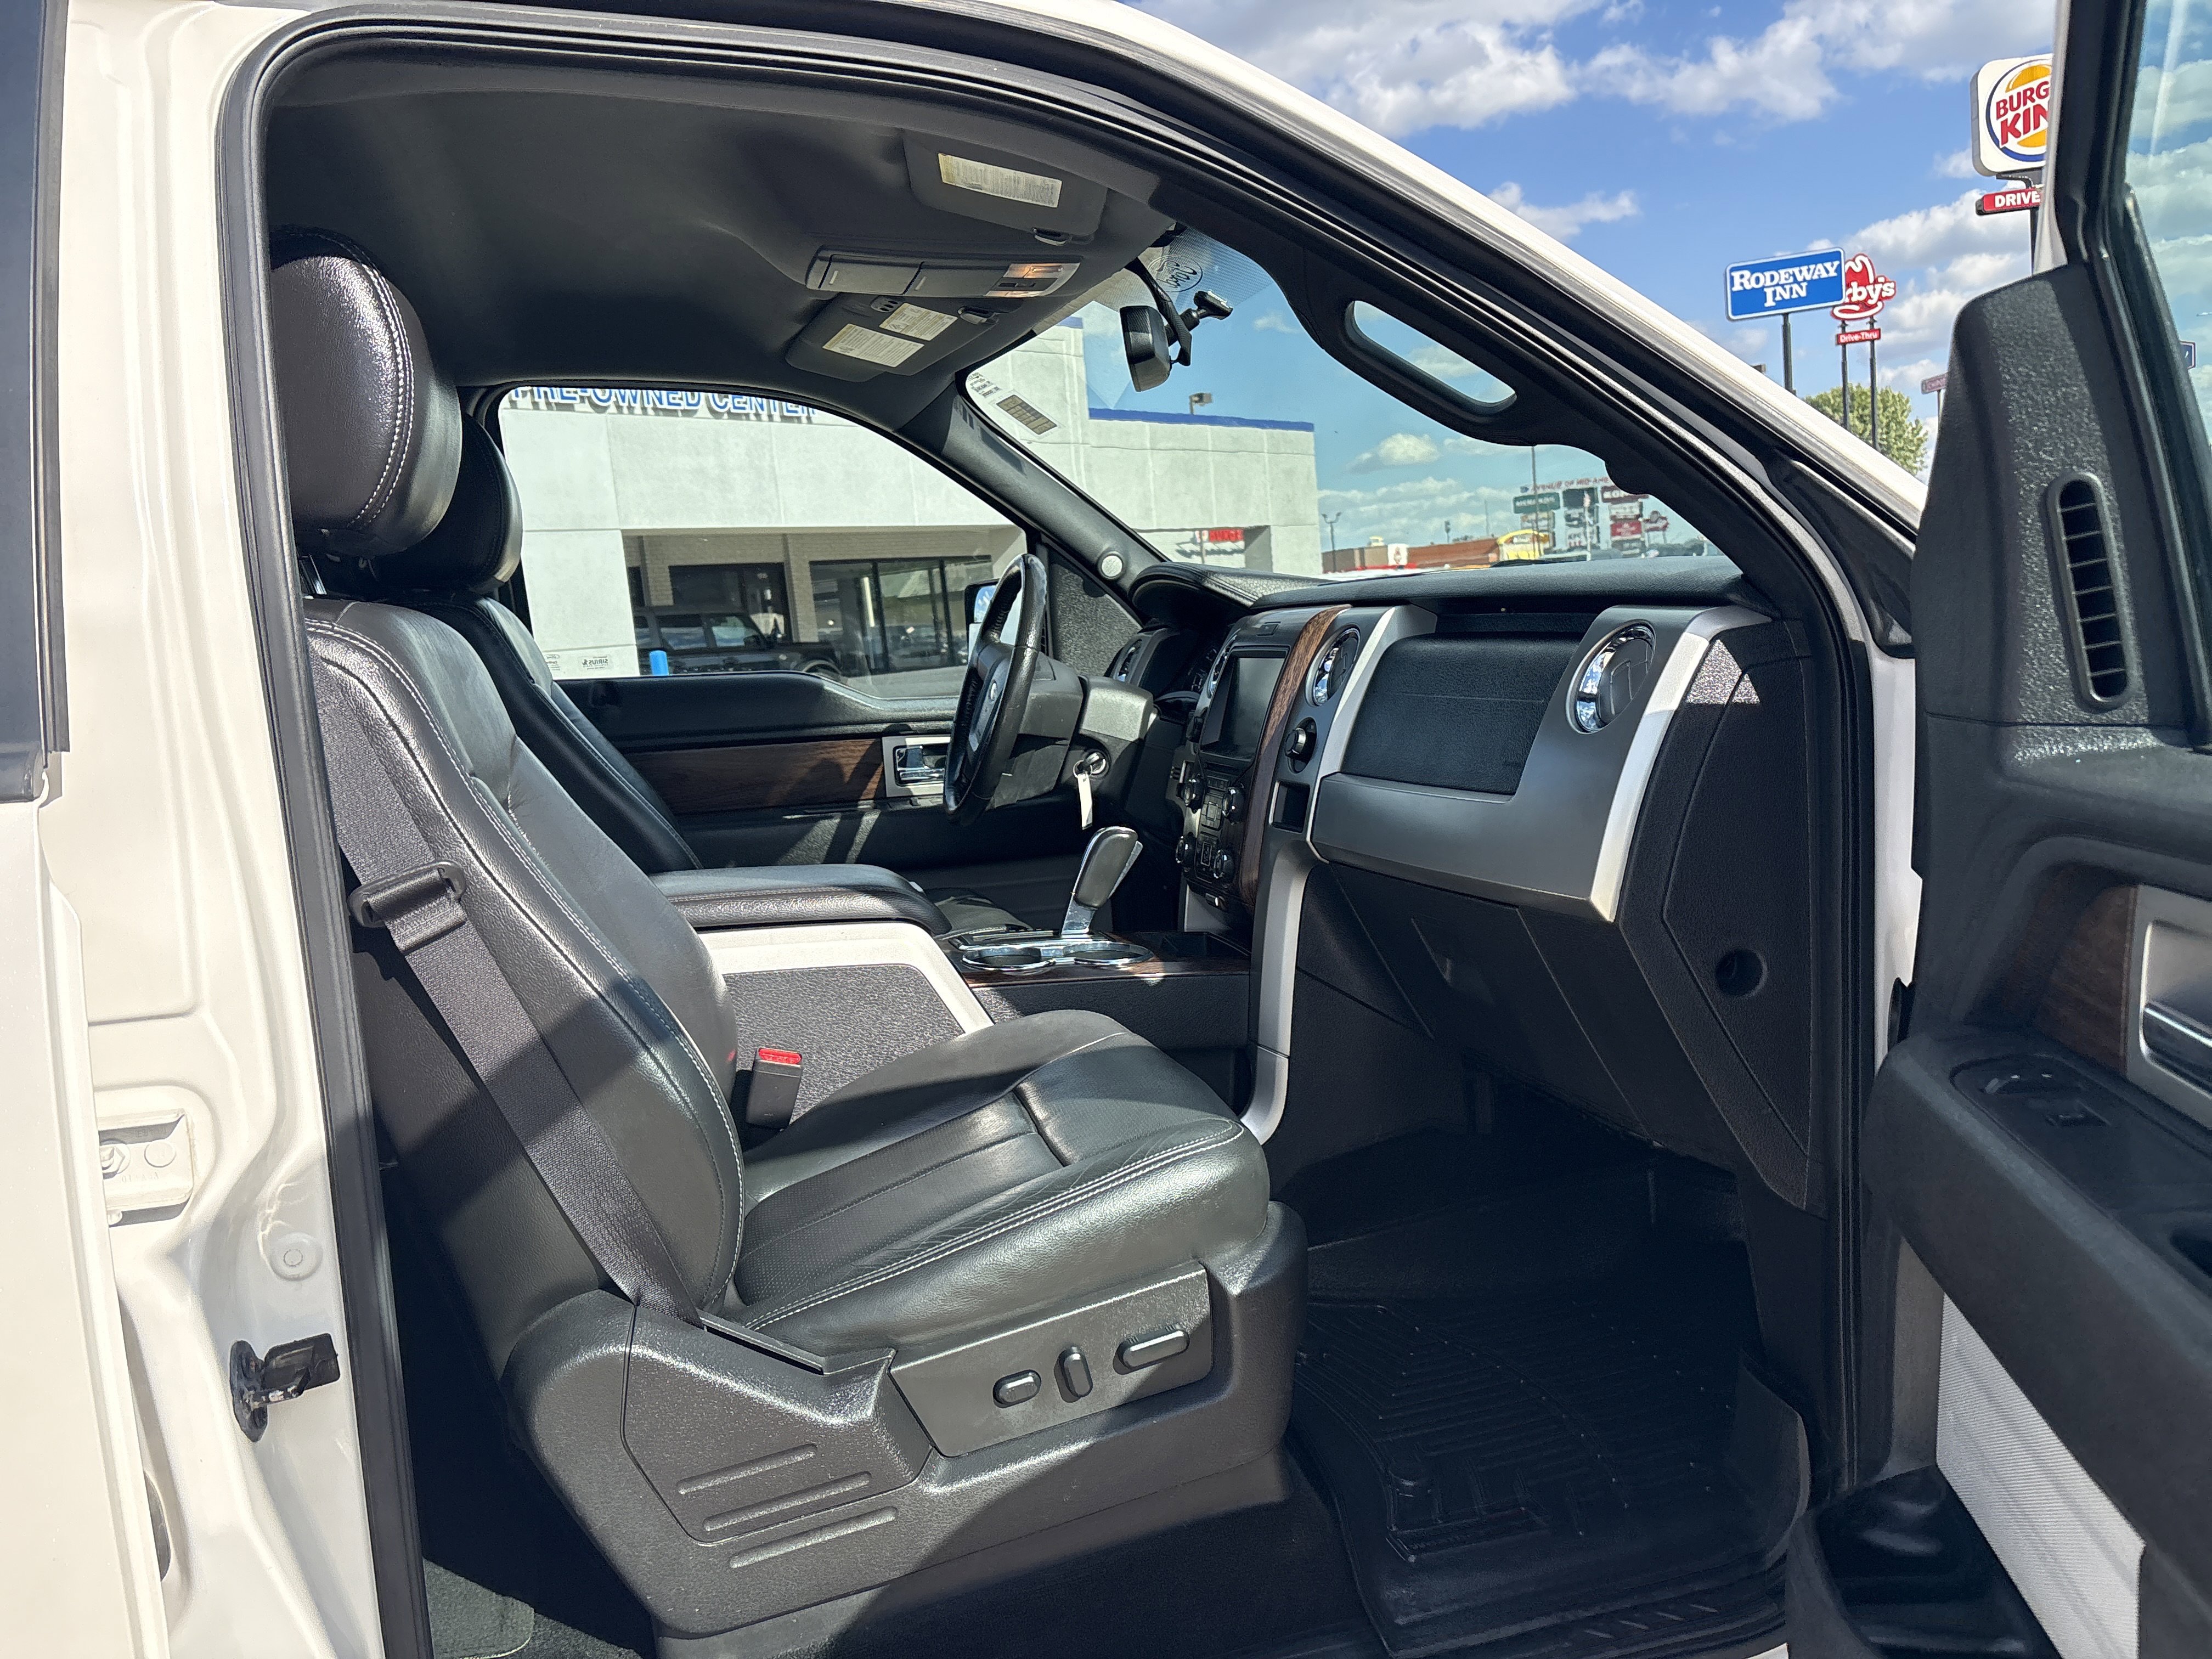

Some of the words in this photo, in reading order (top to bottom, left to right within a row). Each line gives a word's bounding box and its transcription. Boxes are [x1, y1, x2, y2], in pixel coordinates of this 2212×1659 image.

[1996, 81, 2050, 120] BURG
[2000, 104, 2049, 146] KIN
[1994, 191, 2041, 208] DRIVE
[1731, 260, 1840, 291] RODEWAY
[1764, 283, 1808, 308] INN
[1845, 276, 1895, 304] rby's
[1839, 331, 1878, 343] Drive-Thru
